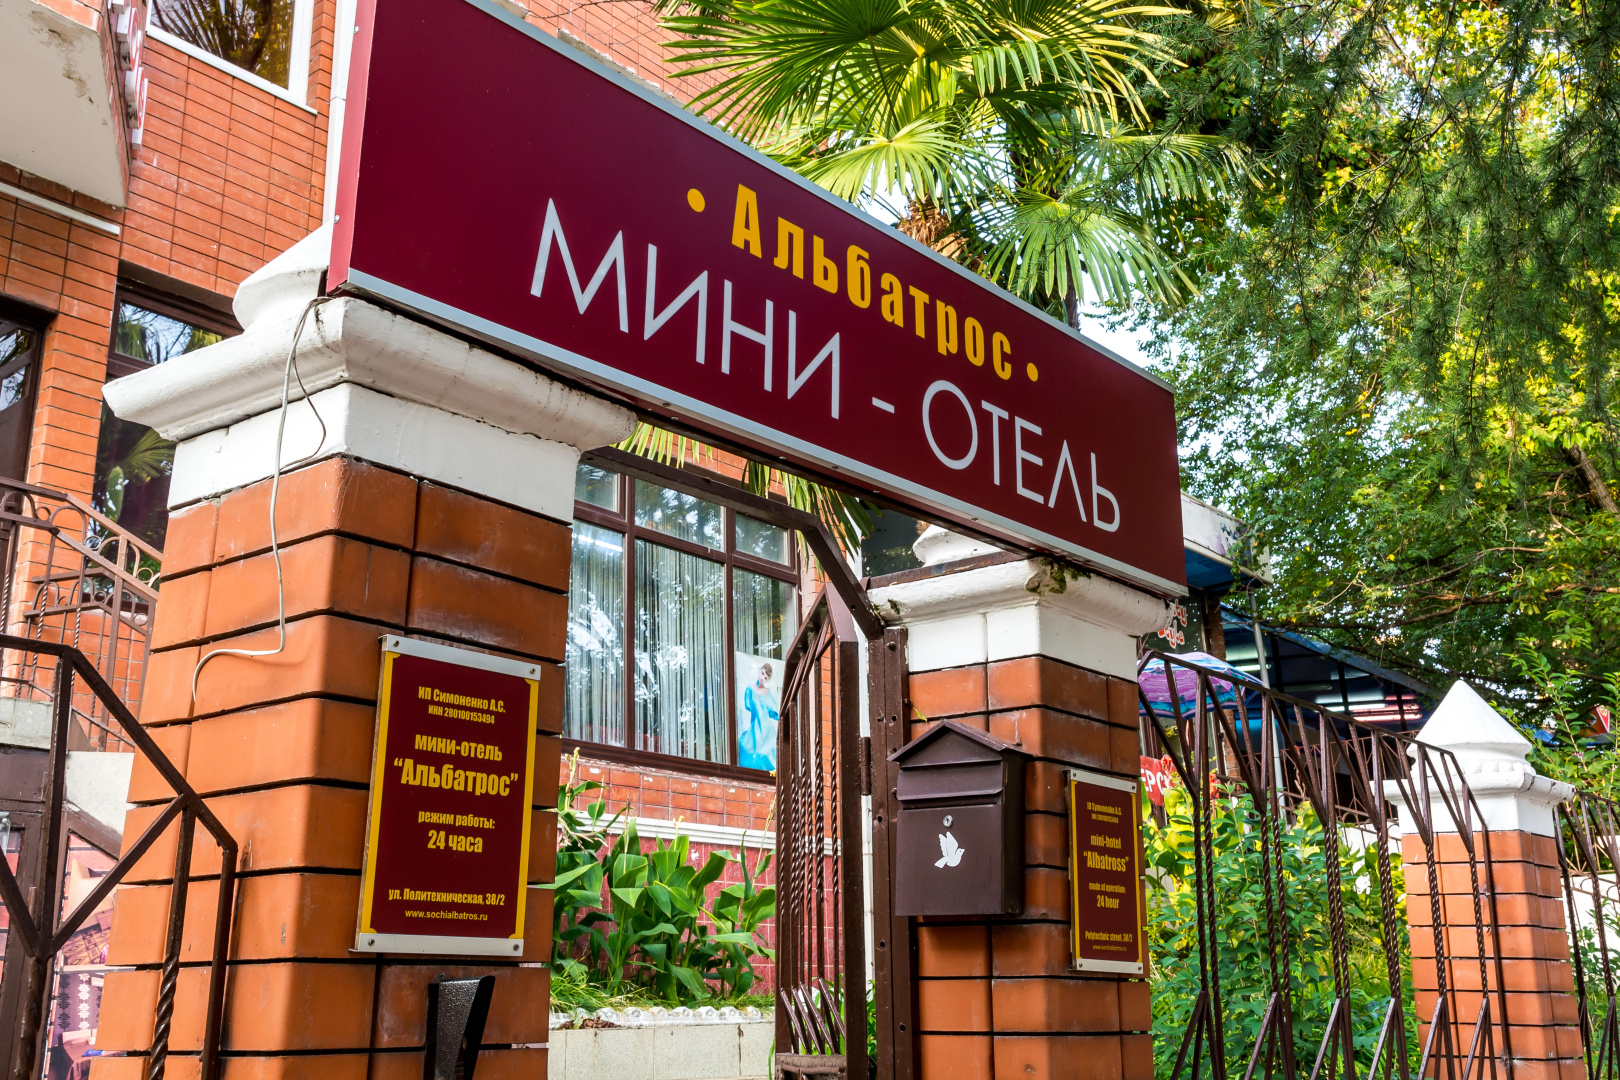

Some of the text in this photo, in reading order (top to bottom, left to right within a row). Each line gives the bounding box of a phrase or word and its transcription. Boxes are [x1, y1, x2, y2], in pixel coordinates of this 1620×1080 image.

[732, 183, 1012, 380] Альбатрос
[530, 197, 840, 420] МИНИ
[922, 380, 1121, 532] ОТЕЛЬ
[418, 686, 506, 713] ИП Симоненко А.С.
[428, 704, 495, 724] ИНН 280100153494
[414, 734, 503, 761] мини-отель
[393, 757, 519, 797] “Альбатрос”
[418, 811, 496, 829] режим работы:
[427, 829, 483, 853] 24 часа
[1090, 833, 1122, 849] mini-hotel
[388, 888, 506, 906] ул. Политехническая, 38/2
[1096, 894, 1120, 909] 24 hour
[405, 910, 488, 921] www.sochialbatros.ru
